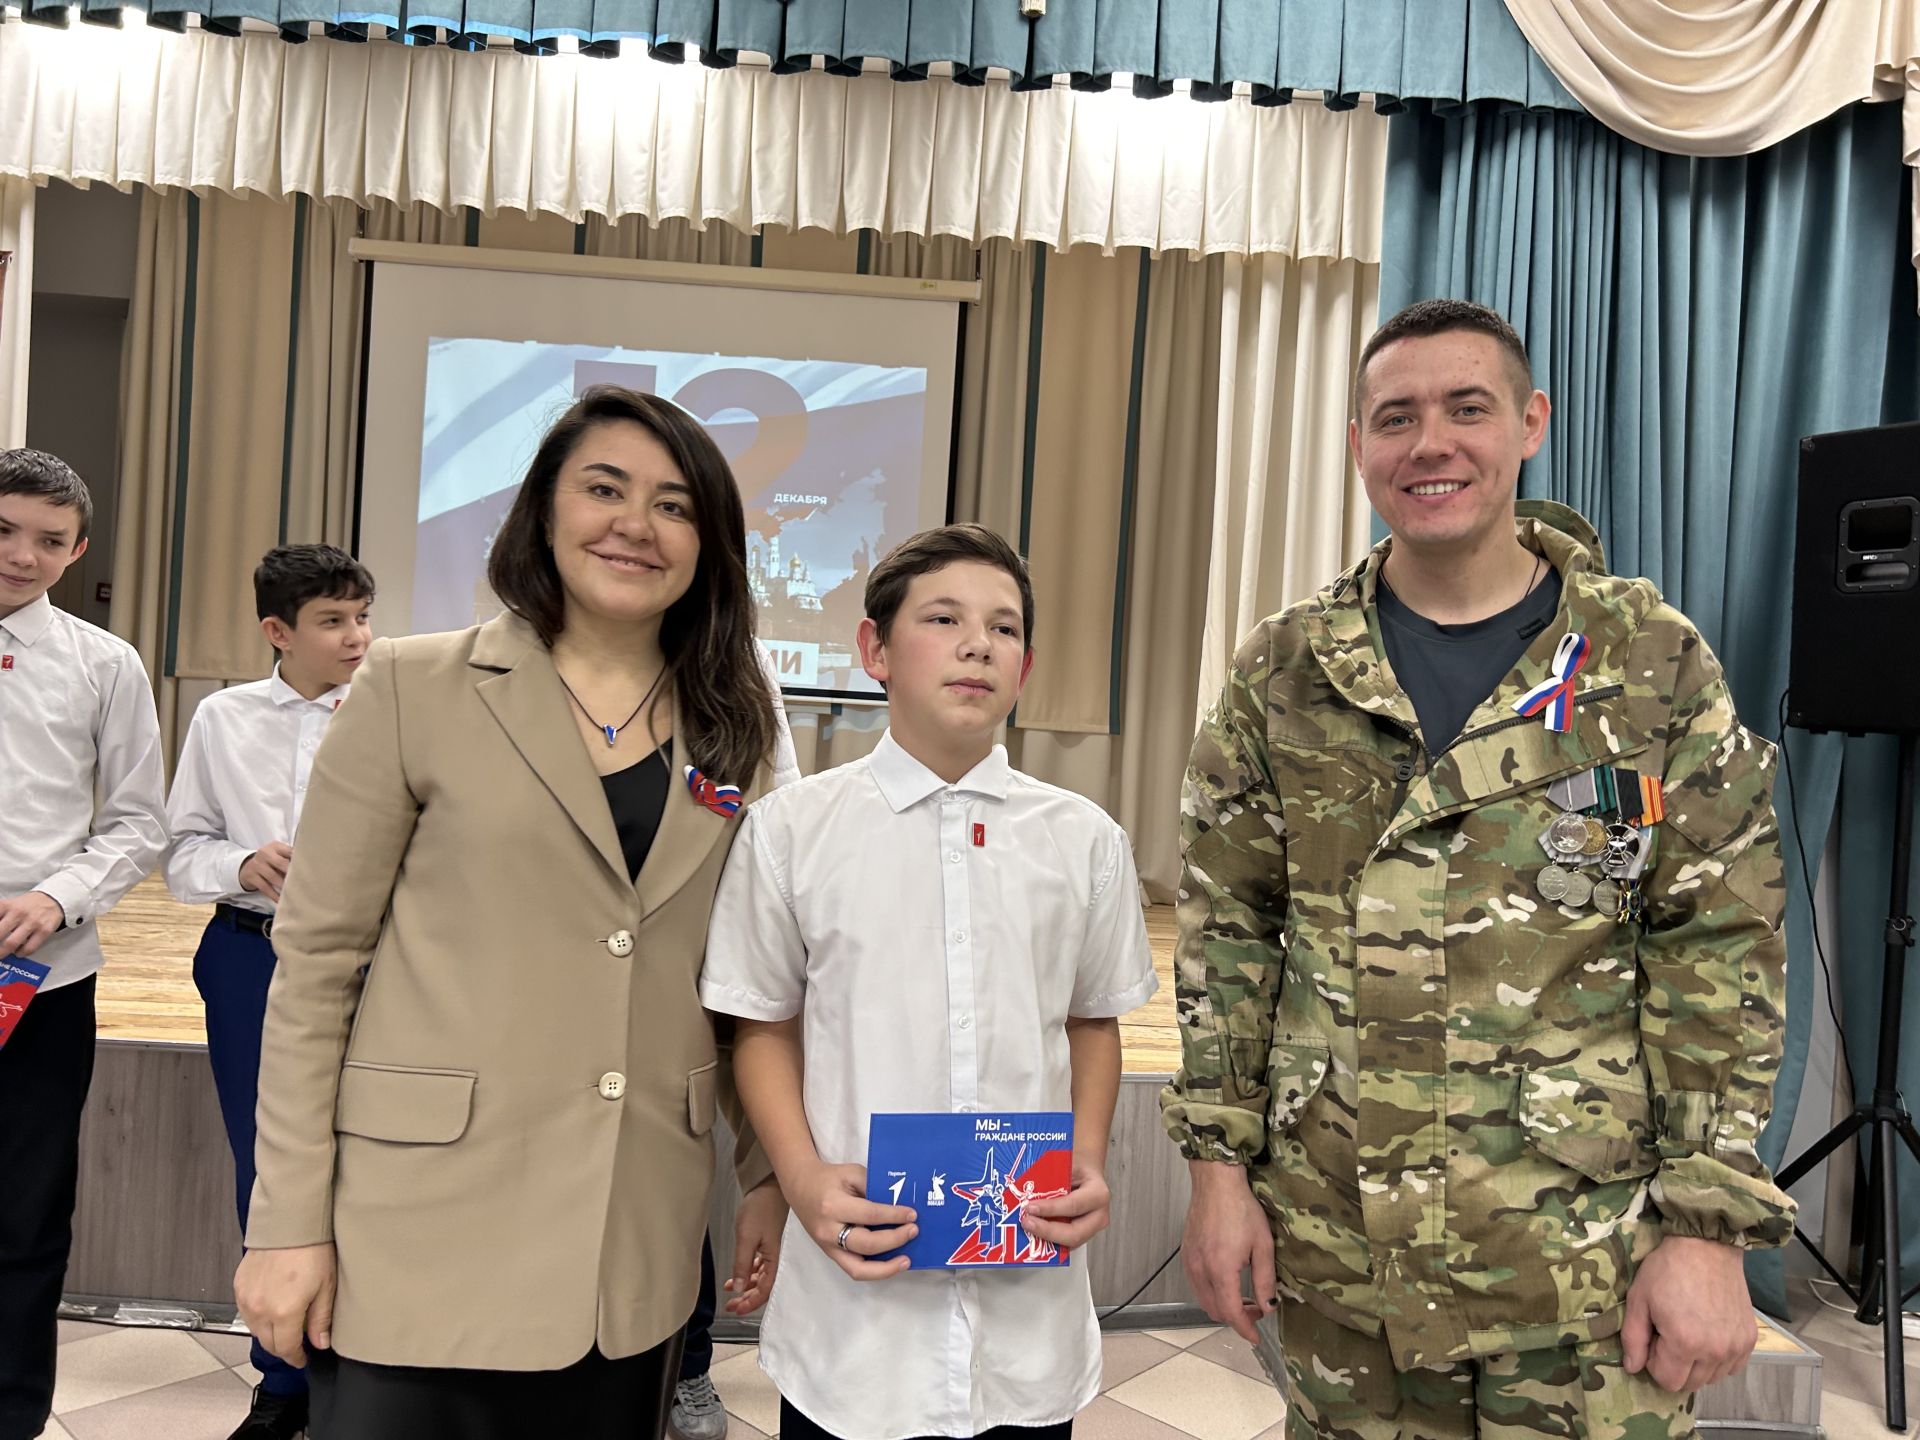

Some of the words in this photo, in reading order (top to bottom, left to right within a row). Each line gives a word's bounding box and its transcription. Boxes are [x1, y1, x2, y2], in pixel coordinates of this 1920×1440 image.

[773, 493, 828, 505] ДЕКАБРЯ
[975, 1118, 1001, 1131] МЫ
[975, 1132, 1026, 1143] ГРАЖДАНЕ
[1026, 1132, 1067, 1142] РОССИИ!
